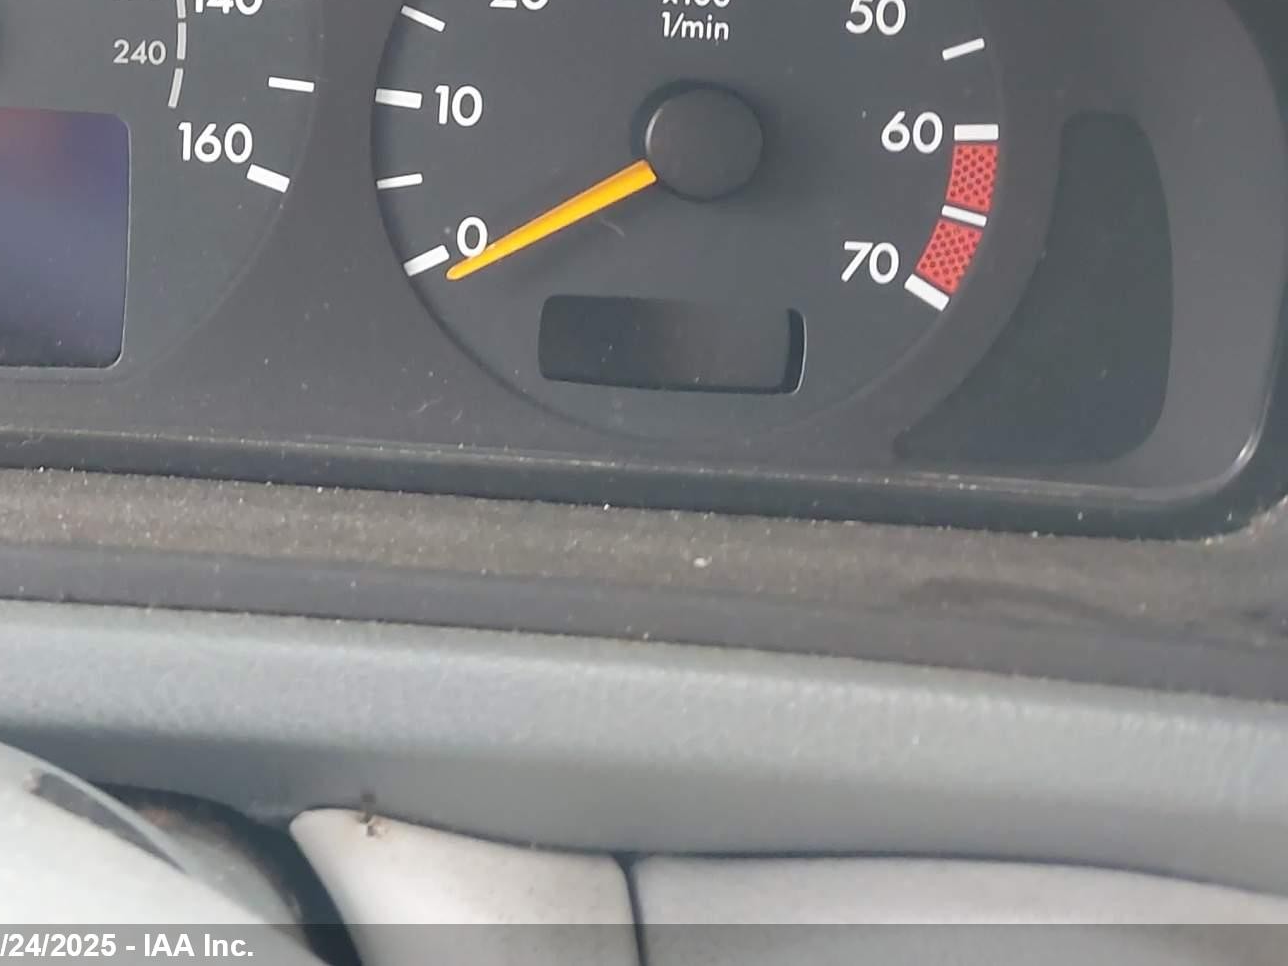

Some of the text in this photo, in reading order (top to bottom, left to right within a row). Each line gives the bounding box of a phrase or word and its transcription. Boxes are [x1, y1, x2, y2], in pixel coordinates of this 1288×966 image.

[661, 13, 730, 41] 1/min
[113, 39, 167, 65] 240
[434, 85, 483, 127] 10
[178, 122, 253, 163] 160
[881, 112, 943, 154] 60
[456, 216, 488, 257] 0
[841, 241, 900, 284] 70
